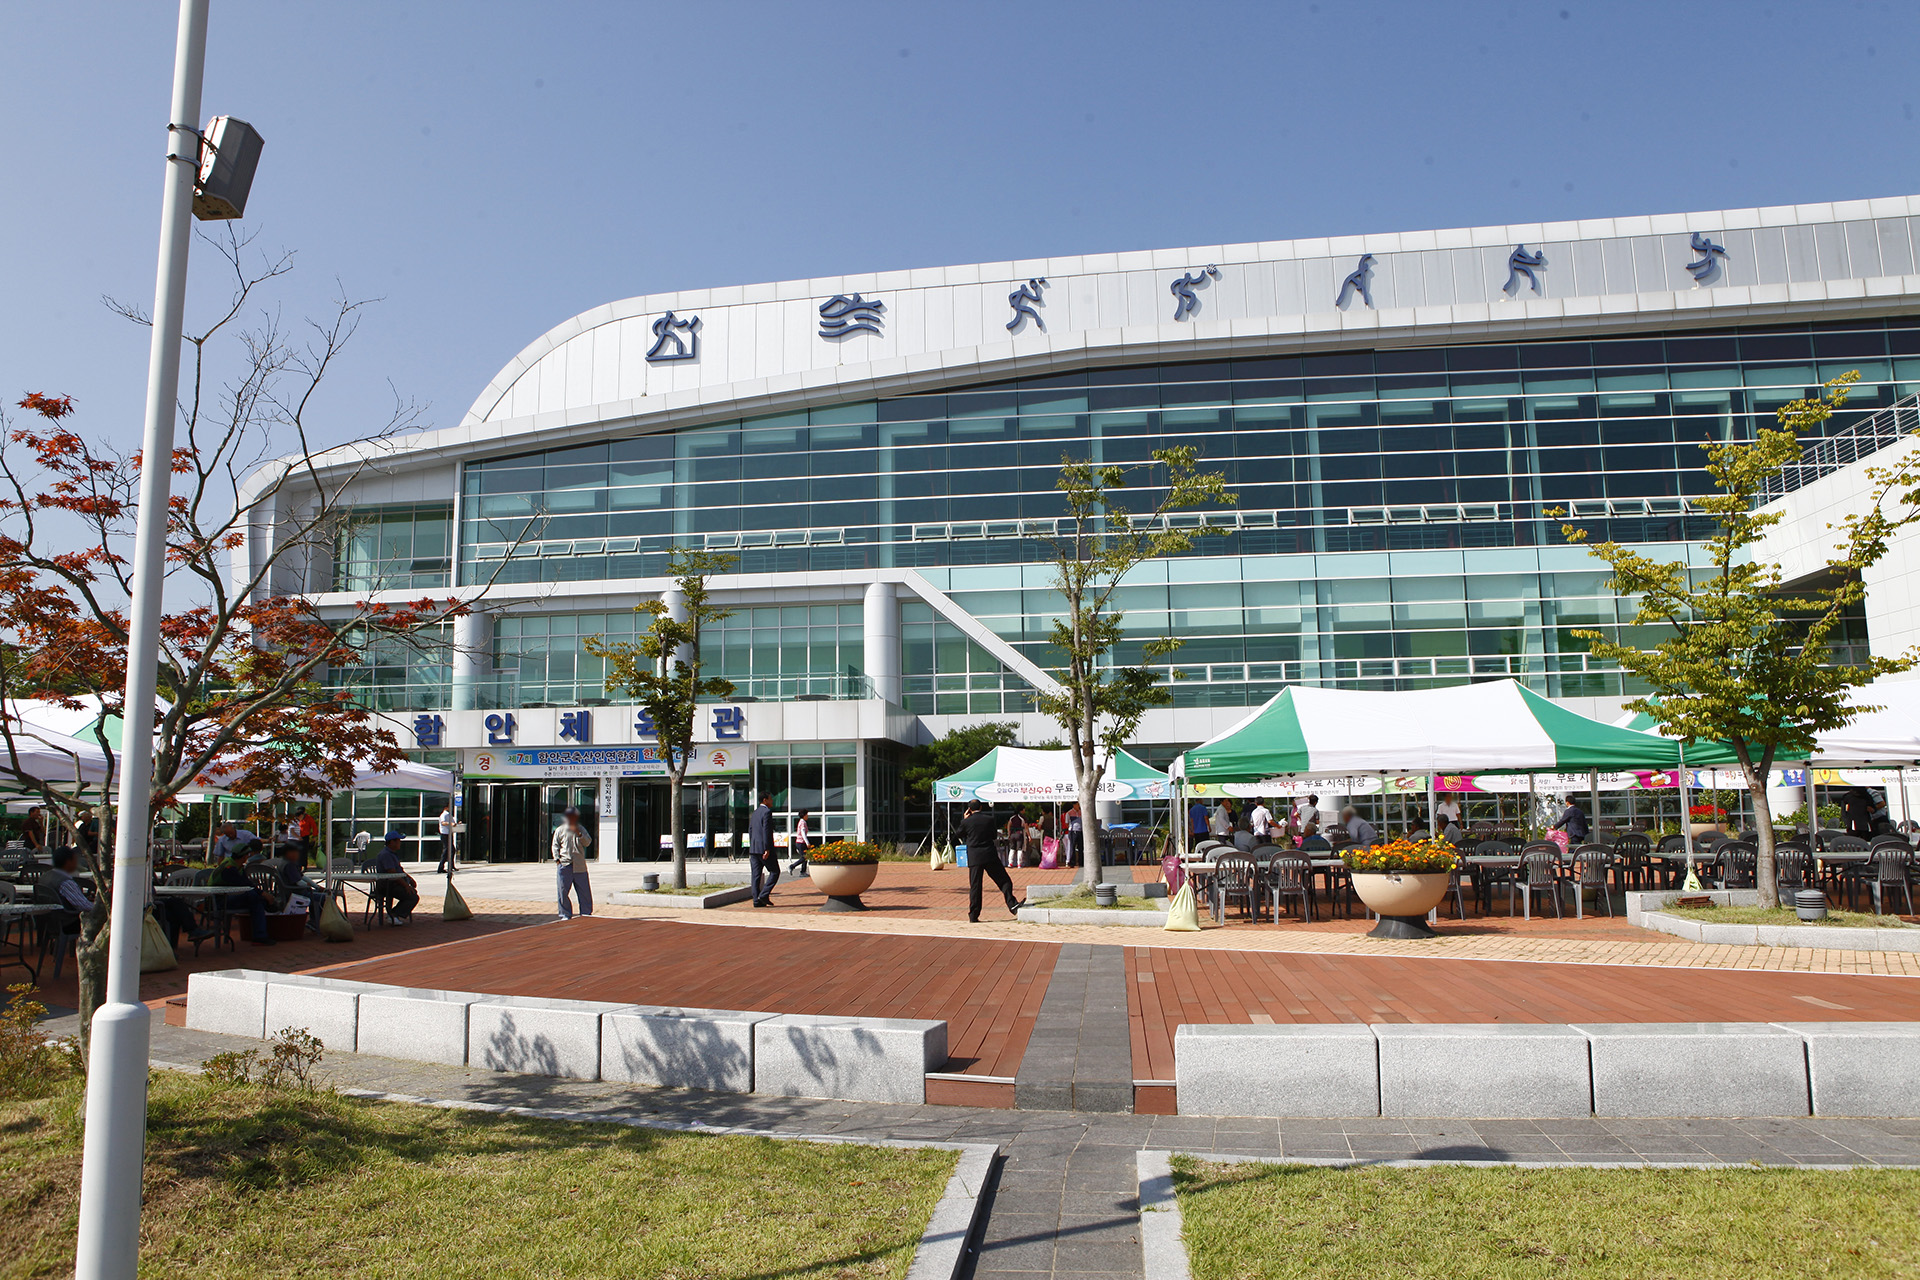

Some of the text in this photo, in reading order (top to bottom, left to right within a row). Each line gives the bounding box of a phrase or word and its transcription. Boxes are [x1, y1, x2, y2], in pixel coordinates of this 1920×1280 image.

[479, 757, 490, 771] 경
[507, 754, 532, 764] 제7회
[538, 750, 639, 765] 함안군축산인연합회
[712, 752, 726, 767] 축
[1580, 772, 1619, 783] 시회장
[1055, 783, 1074, 793] 무료
